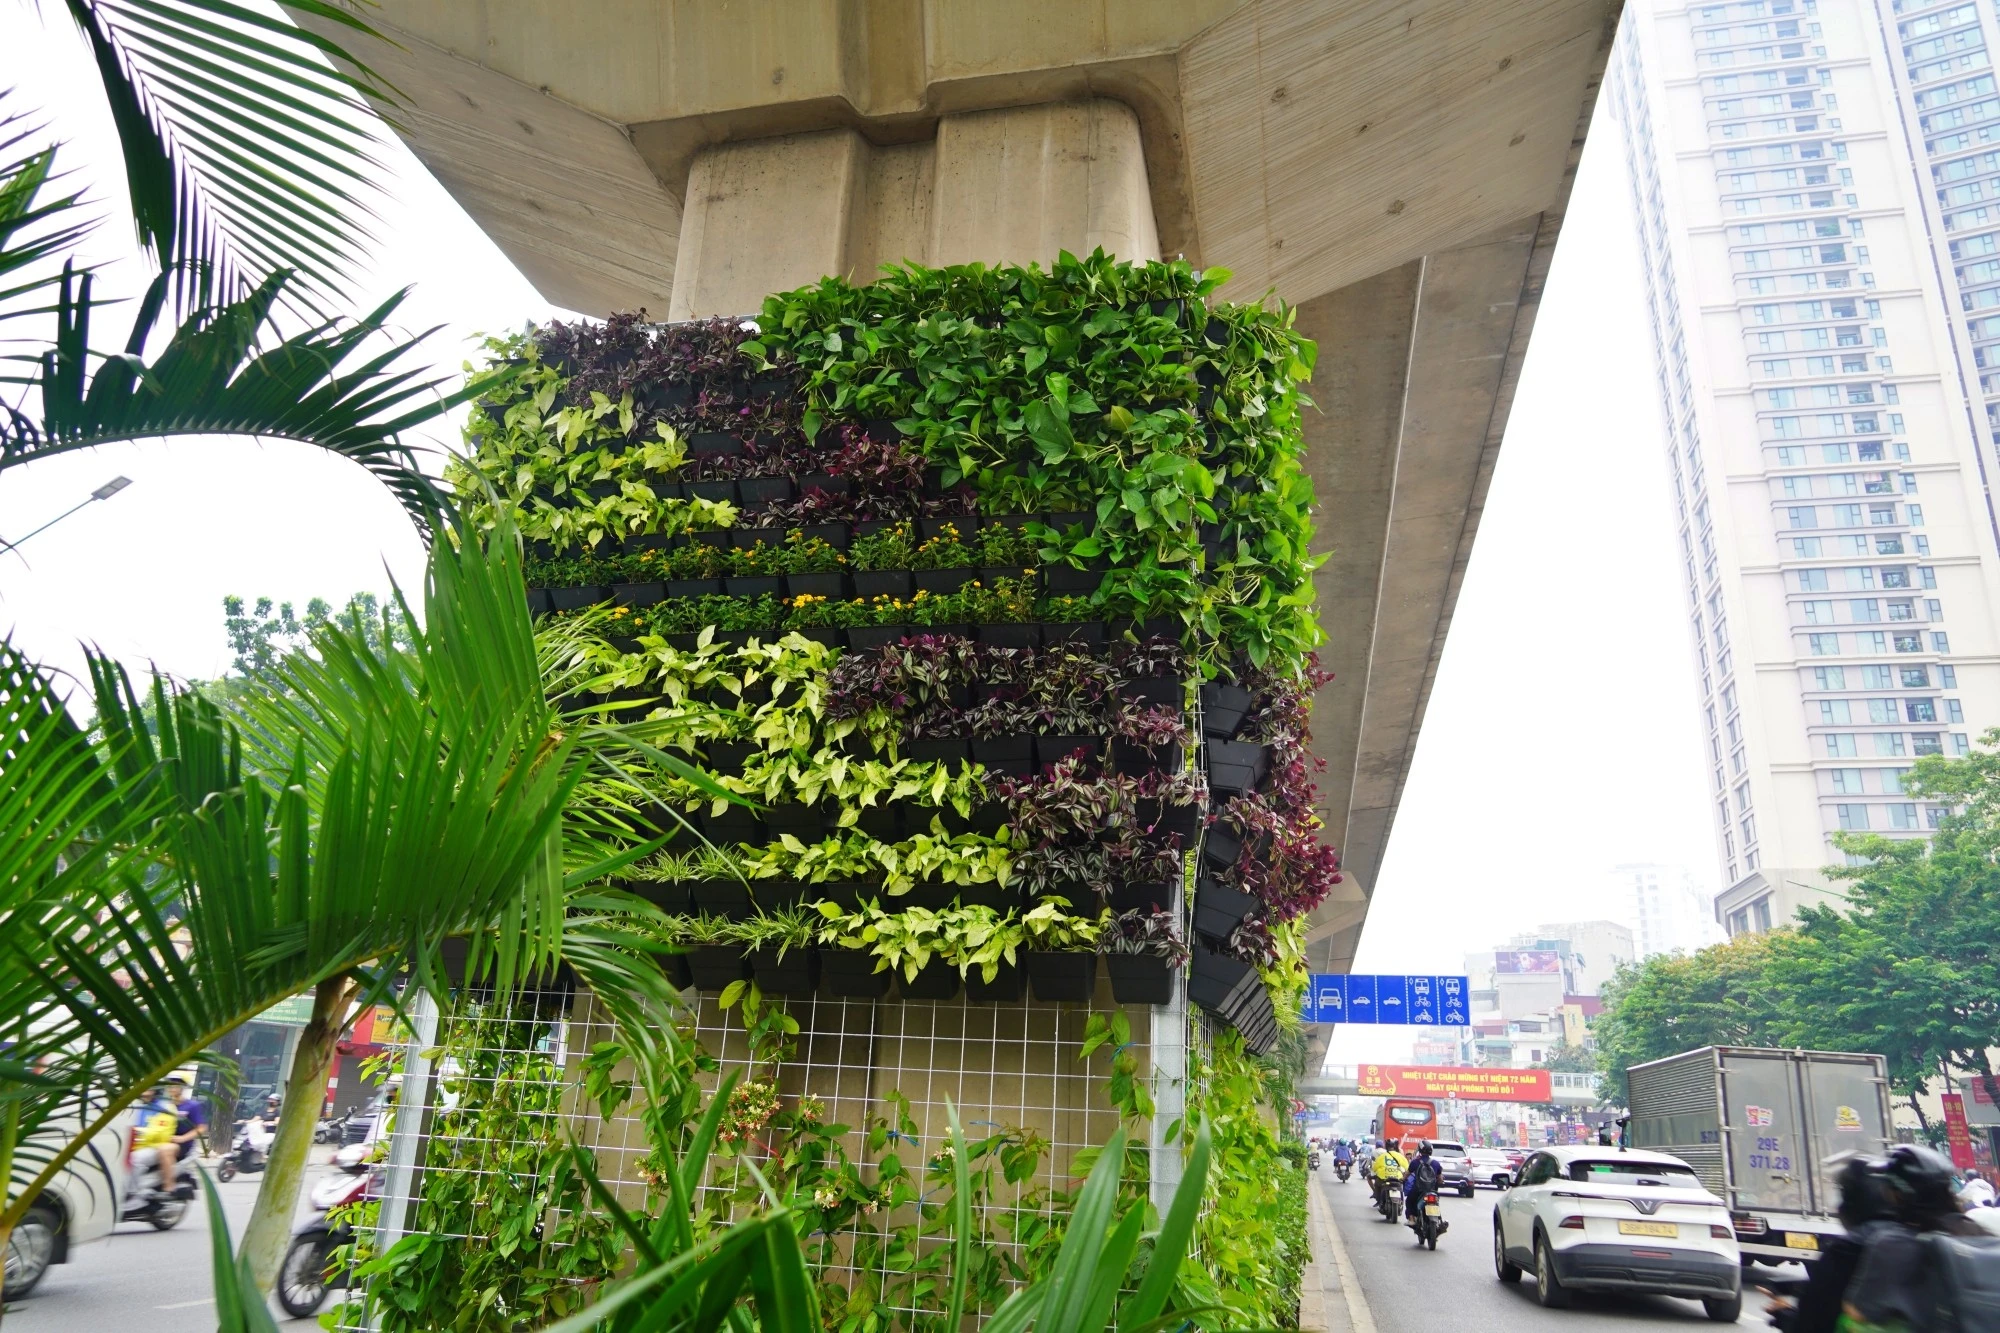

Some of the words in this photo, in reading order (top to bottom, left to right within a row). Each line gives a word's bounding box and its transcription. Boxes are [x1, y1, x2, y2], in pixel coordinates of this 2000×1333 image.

[1423, 1072, 1437, 1081] LIỆT
[1757, 1137, 1779, 1151] 29E
[1750, 1155, 1790, 1170] 371.28
